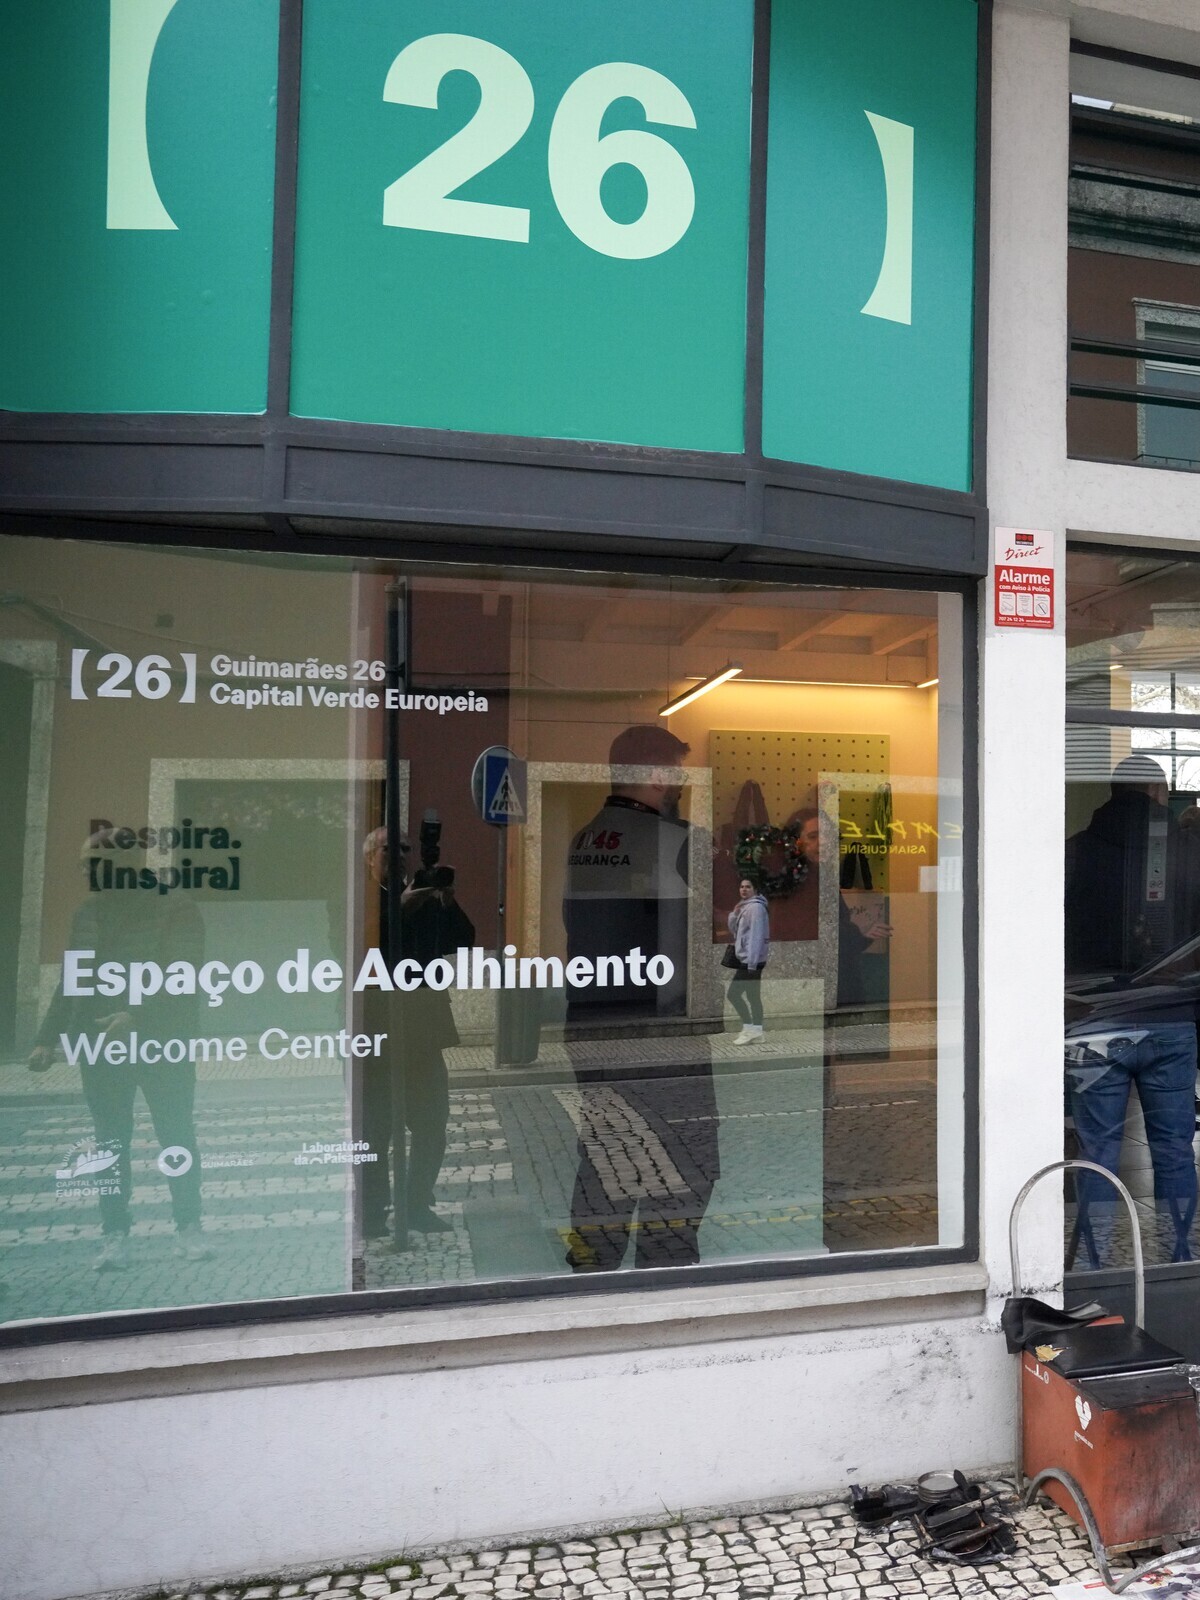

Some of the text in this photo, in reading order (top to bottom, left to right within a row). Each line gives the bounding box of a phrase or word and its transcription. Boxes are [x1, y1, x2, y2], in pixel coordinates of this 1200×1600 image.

[999, 568, 1051, 585] Alarme
[210, 653, 386, 682] Guimarães 26
[210, 682, 489, 715] Capital Verde Europeia
[90, 817, 242, 855] Respira.
[62, 943, 675, 1007] Espaço de Acolhimento
[58, 1026, 388, 1067] Welcome Center
[302, 1139, 370, 1154] Laboratório
[294, 1152, 378, 1166] da Paisagem
[55, 1180, 90, 1188] CAPITAL
[55, 1186, 121, 1198] EUROPEIA
